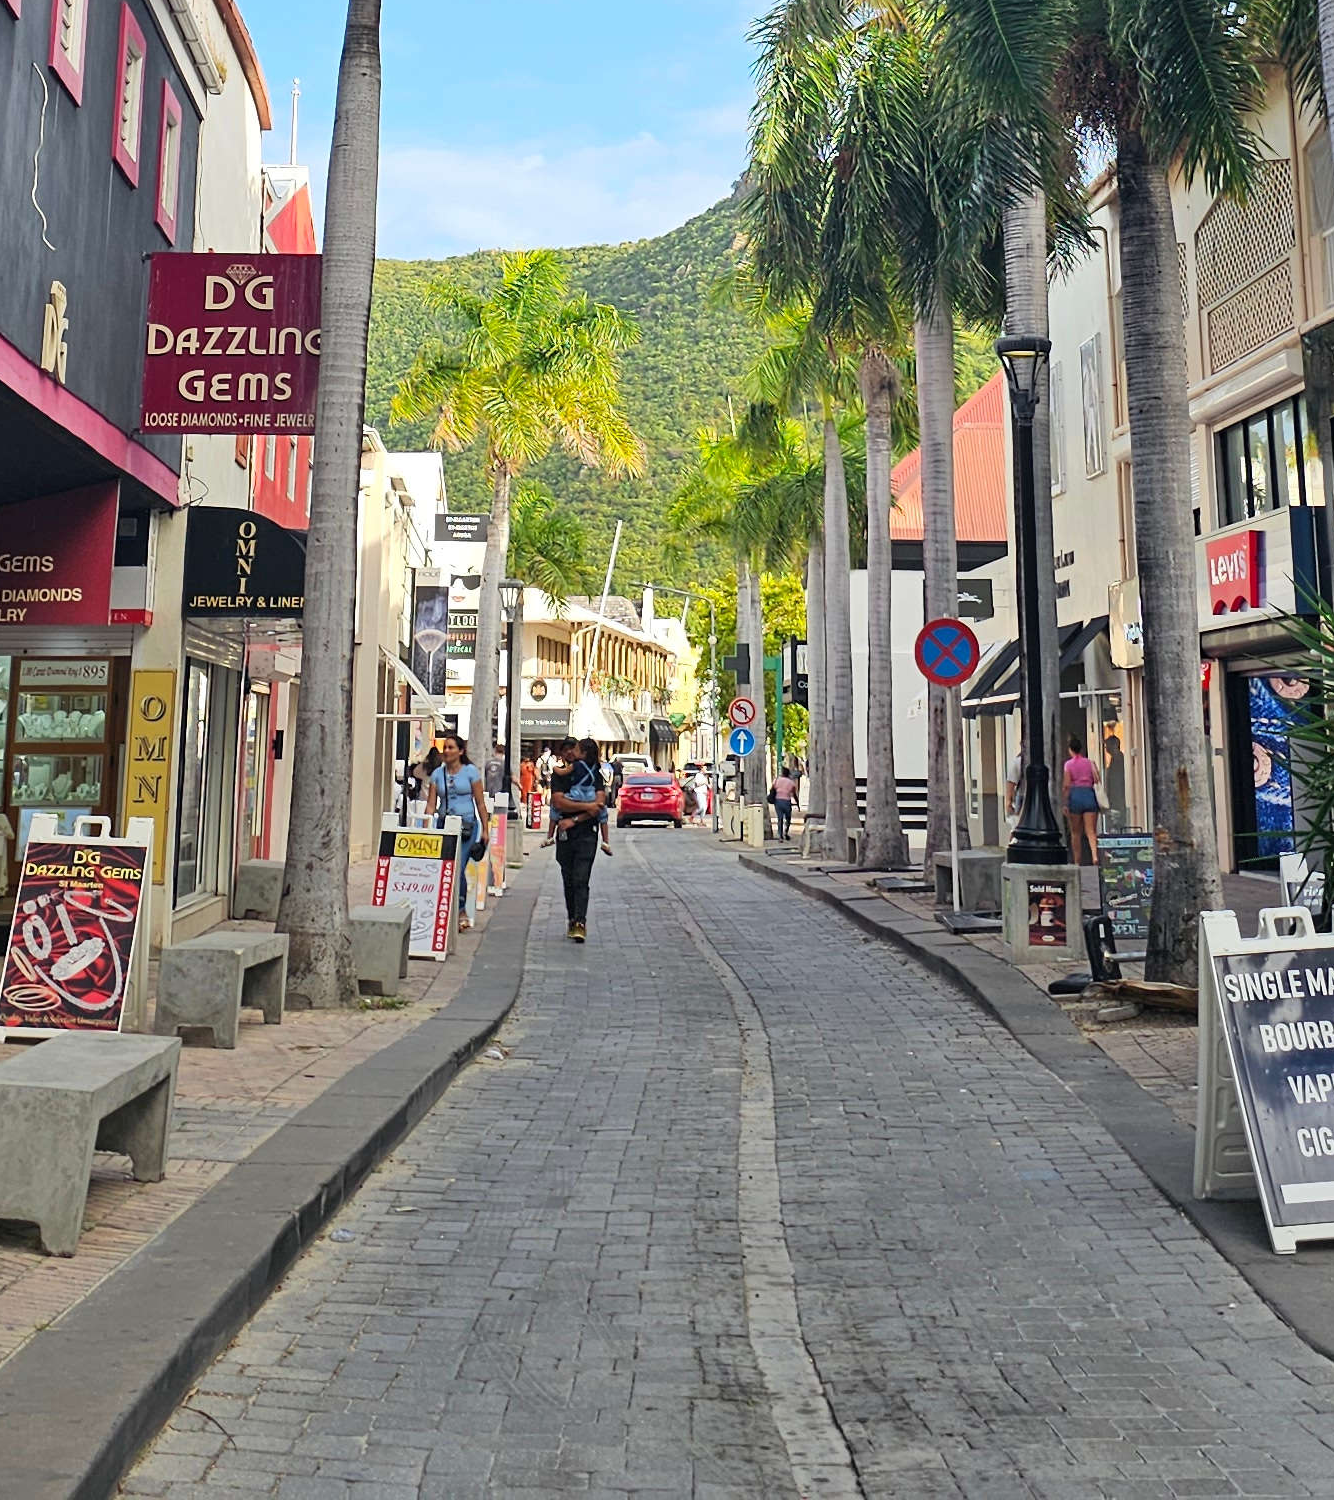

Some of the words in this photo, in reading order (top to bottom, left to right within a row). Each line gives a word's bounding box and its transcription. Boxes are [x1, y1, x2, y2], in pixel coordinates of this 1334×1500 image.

[204, 275, 275, 311] DG
[147, 322, 321, 356] DAZZLING
[178, 369, 293, 402] GEMS
[145, 412, 179, 427] LOOSE
[180, 412, 238, 427] DIAMONDS
[243, 413, 271, 427] FINE
[274, 413, 316, 428] JEWELR
[235, 521, 258, 594] OMNI
[1, 587, 83, 603] DIAMONDS
[189, 595, 254, 608] JEWELRY
[256, 596, 267, 608] &
[82, 665, 107, 679] 895
[132, 694, 168, 804] OMN
[397, 837, 440, 851] OMNI
[73, 850, 101, 865] DG
[26, 862, 95, 878] DAZZLING
[100, 865, 142, 880] GEMS
[392, 881, 435, 893] $349.00
[1029, 884, 1045, 893] Sold
[1223, 968, 1306, 1004] SINGLE
